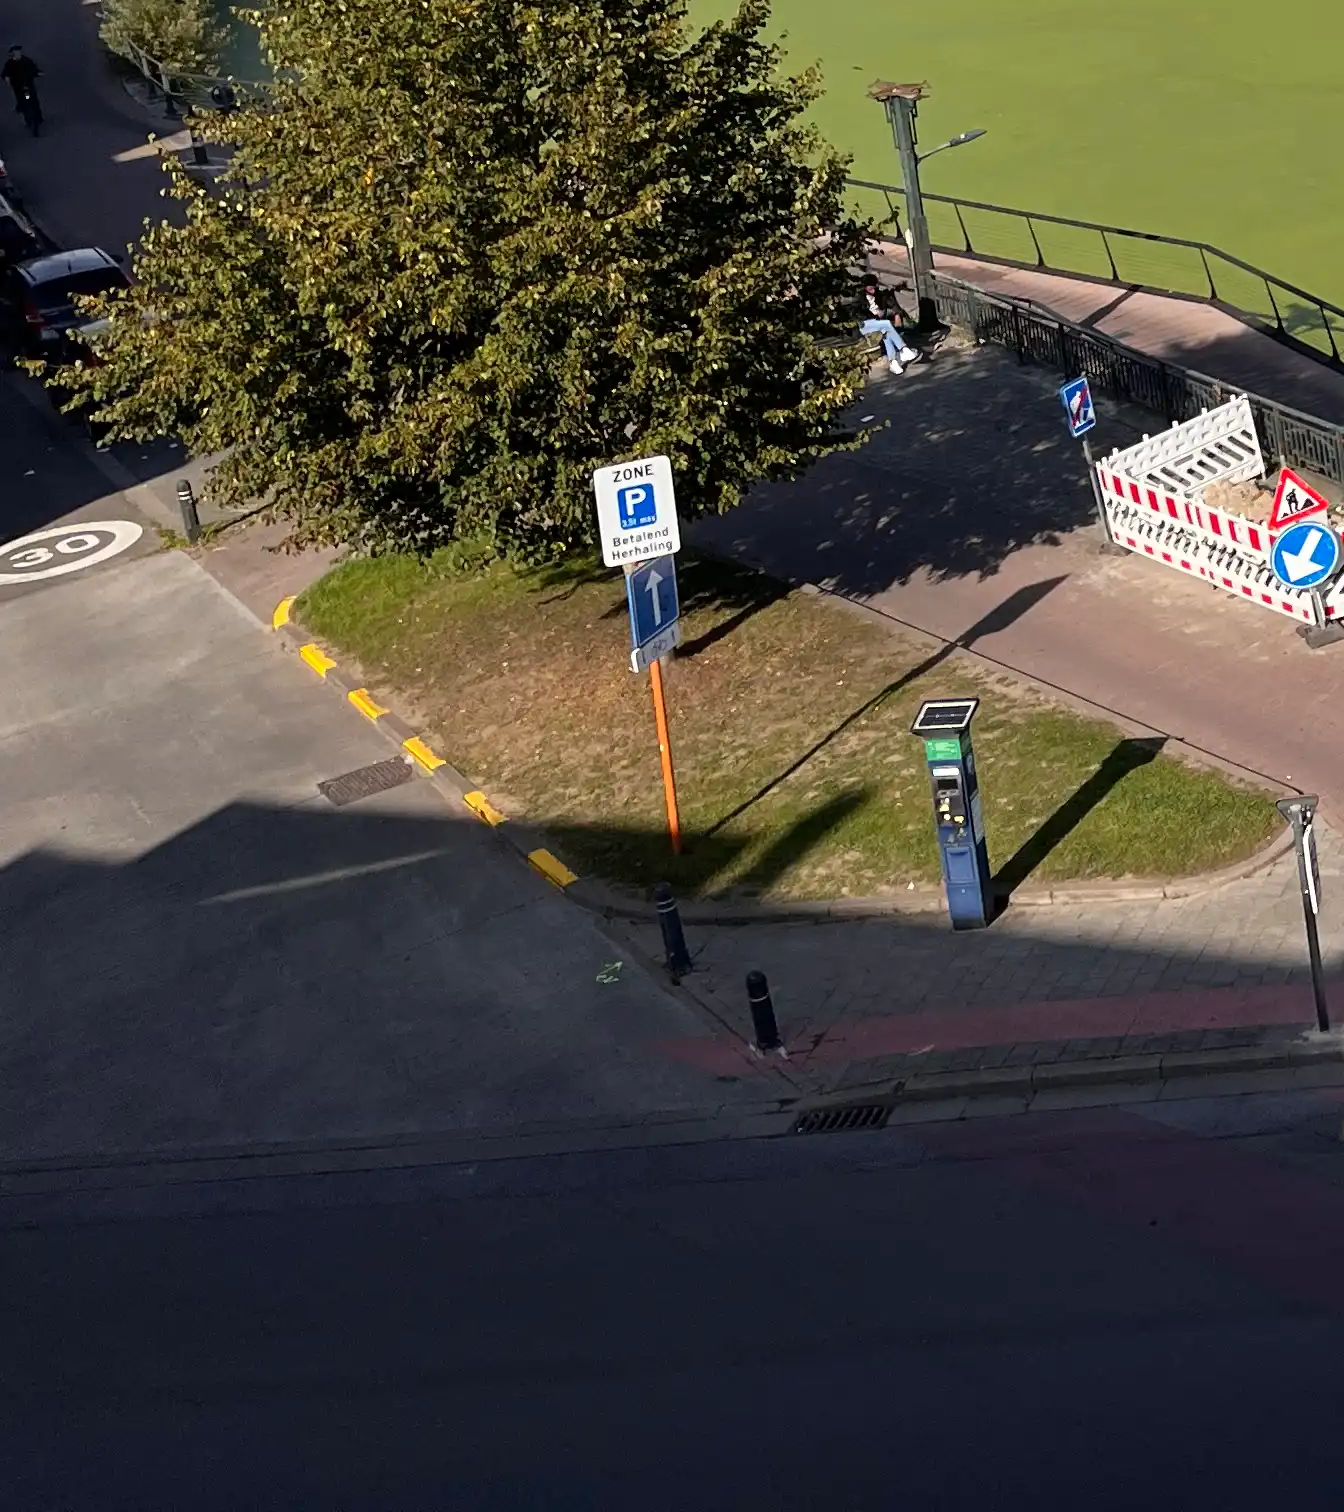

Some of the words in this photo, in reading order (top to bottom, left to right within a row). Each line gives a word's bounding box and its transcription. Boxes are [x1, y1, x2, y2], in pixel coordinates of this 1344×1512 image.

[612, 464, 655, 483] ZONE
[625, 488, 647, 516] P
[612, 527, 669, 547] Betalend
[9, 533, 101, 568] 30
[611, 541, 673, 560] Herhaling
